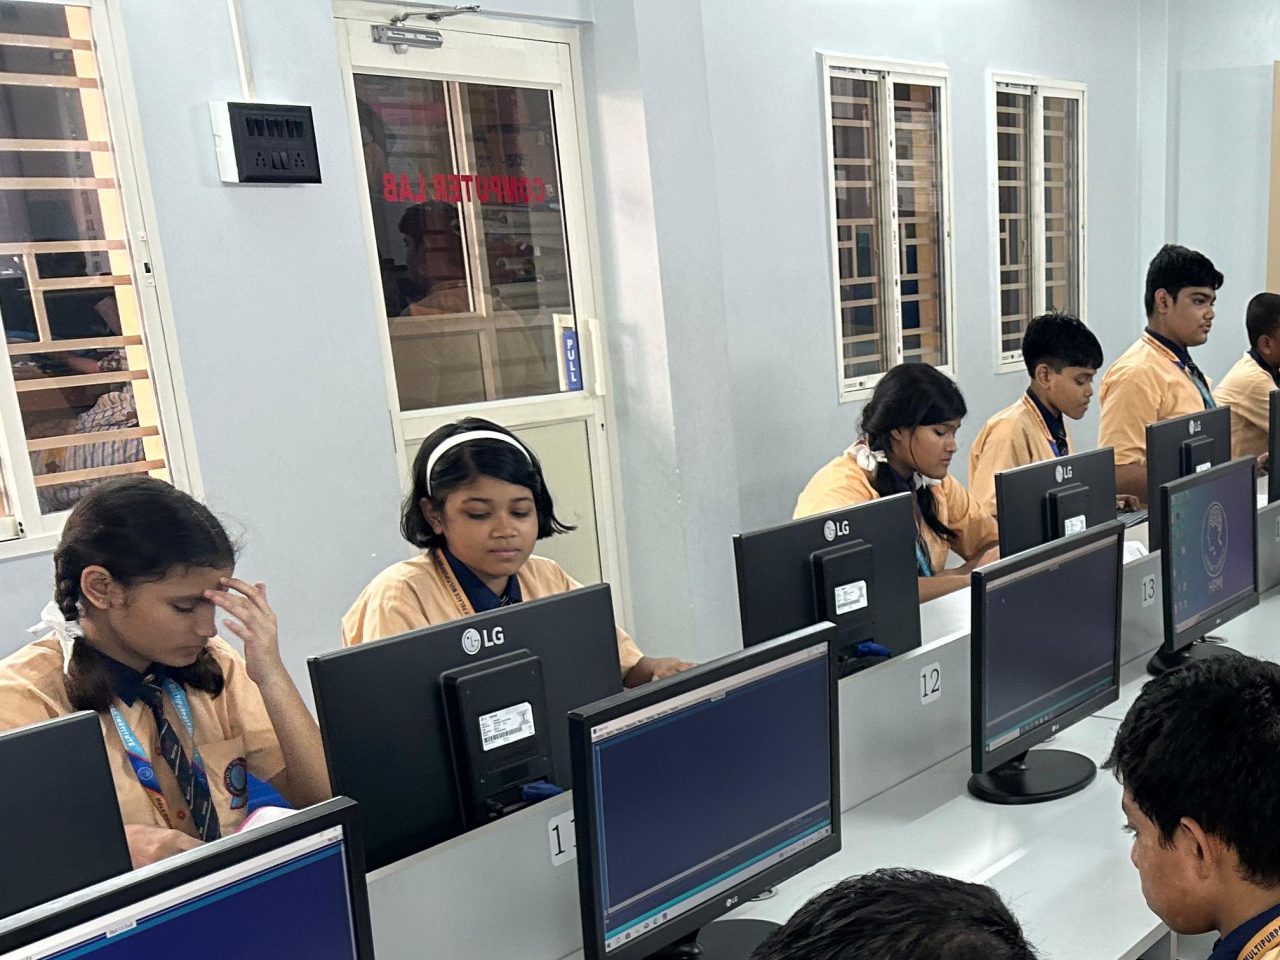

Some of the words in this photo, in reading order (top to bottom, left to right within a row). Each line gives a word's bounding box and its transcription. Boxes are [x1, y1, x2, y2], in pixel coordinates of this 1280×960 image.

[567, 339, 577, 382] PULL
[1064, 466, 1072, 479] LG
[836, 520, 849, 536] LG
[1142, 578, 1155, 601] 13
[483, 626, 504, 647] LG
[921, 668, 940, 698] 12
[552, 818, 576, 857] 1
